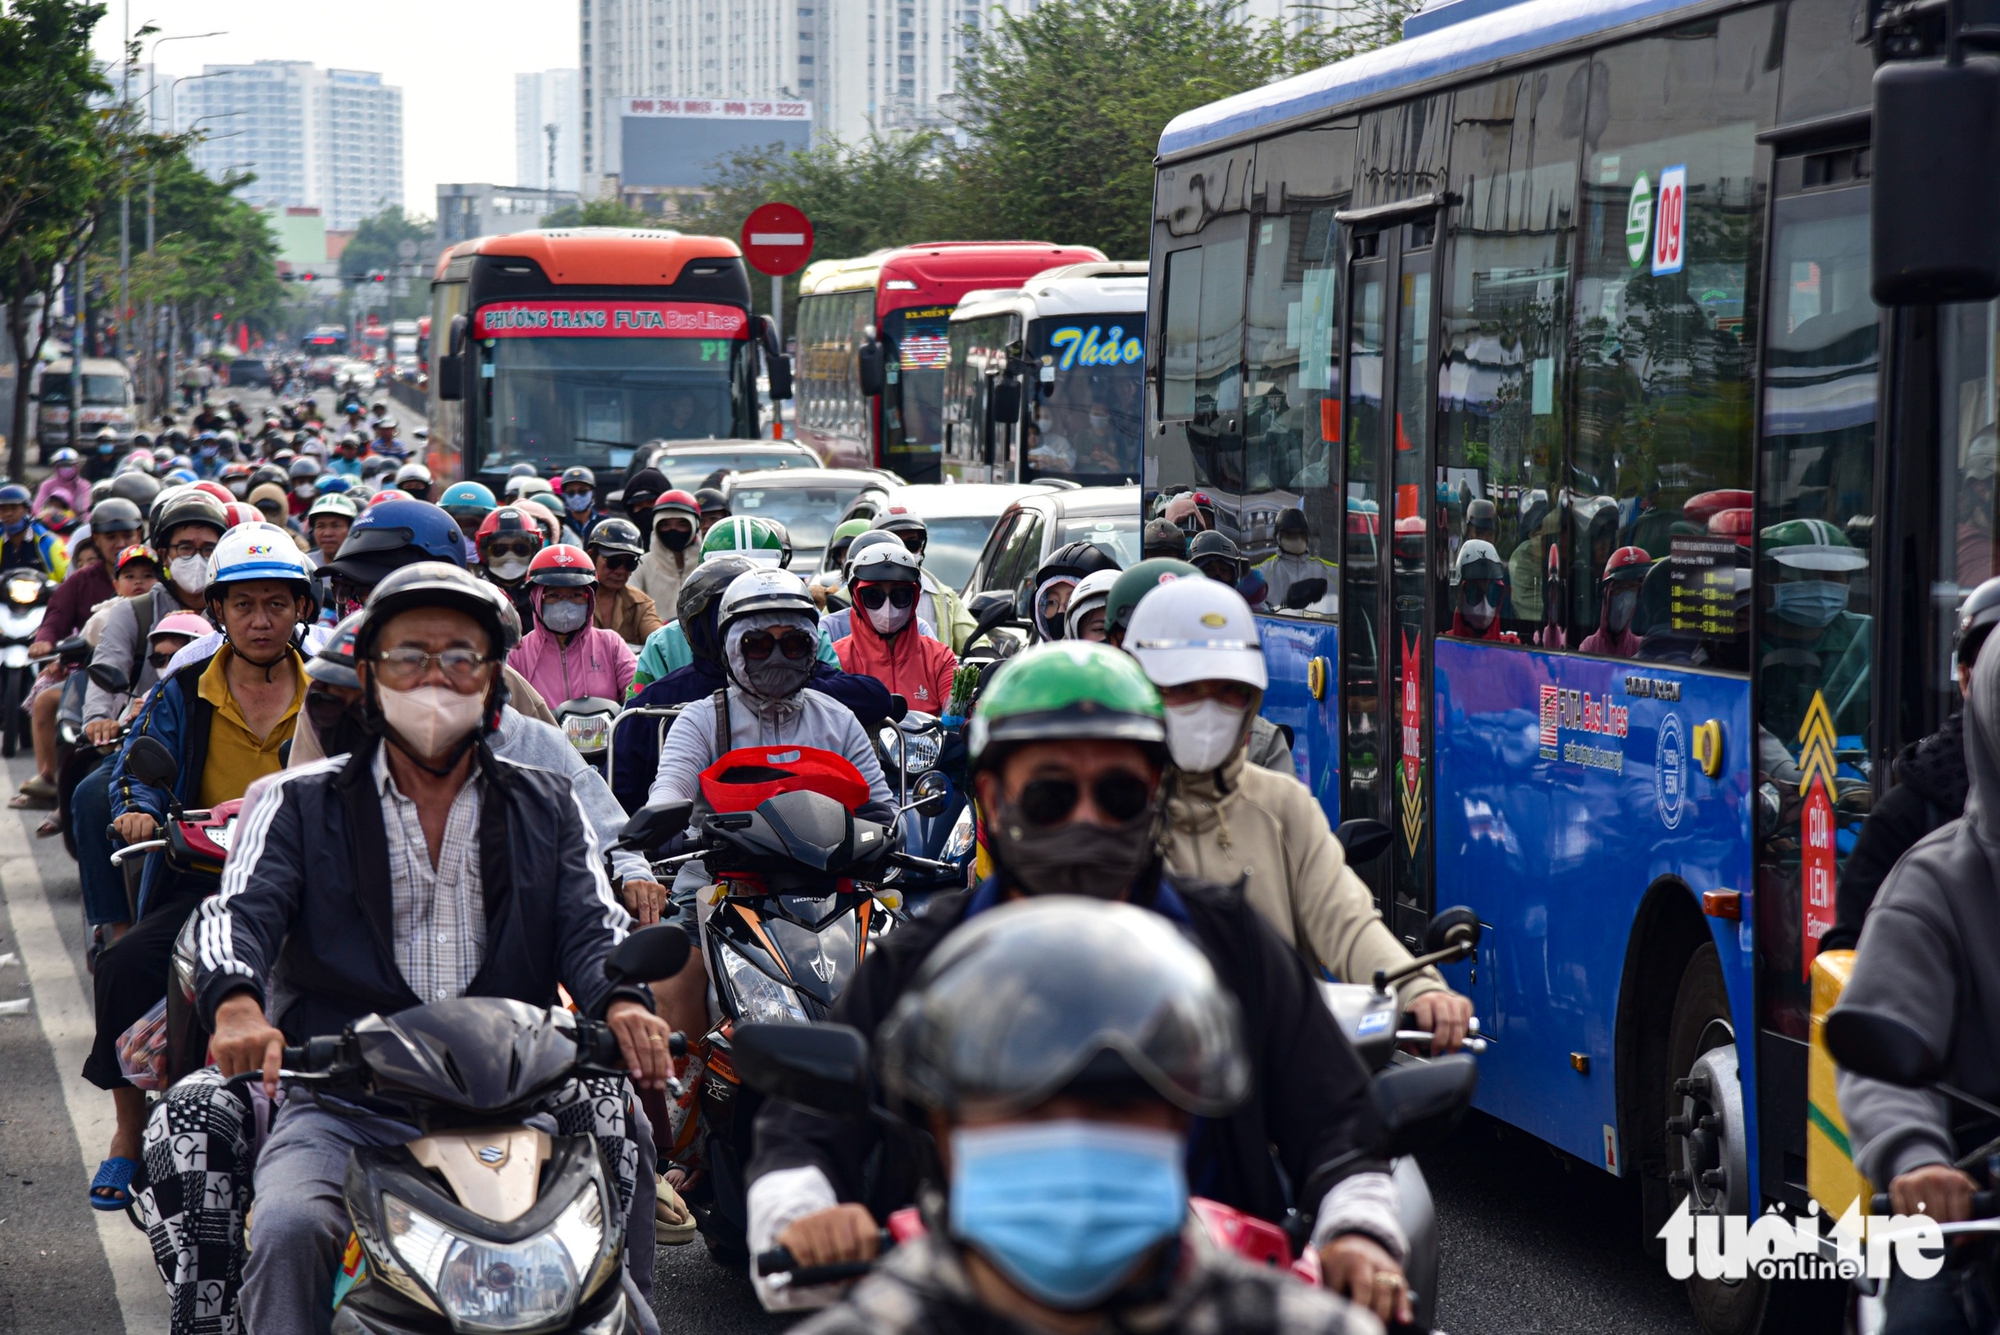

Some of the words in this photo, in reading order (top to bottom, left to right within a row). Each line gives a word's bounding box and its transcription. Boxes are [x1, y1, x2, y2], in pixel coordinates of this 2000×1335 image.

[1658, 185, 1682, 264] 09
[485, 307, 549, 329] PHƯƠNG
[551, 310, 607, 328] TRANG
[613, 311, 665, 329] FUTA
[1051, 325, 1143, 371] Thảo
[1558, 688, 1582, 731] FUTA
[1584, 692, 1601, 734] Bus
[1602, 694, 1628, 739] Lines
[1809, 795, 1828, 849] CỬA
[792, 896, 826, 904] HONDA
[1809, 858, 1828, 908] LÊN
[173, 1134, 207, 1167] CK
[197, 1282, 223, 1314] CK
